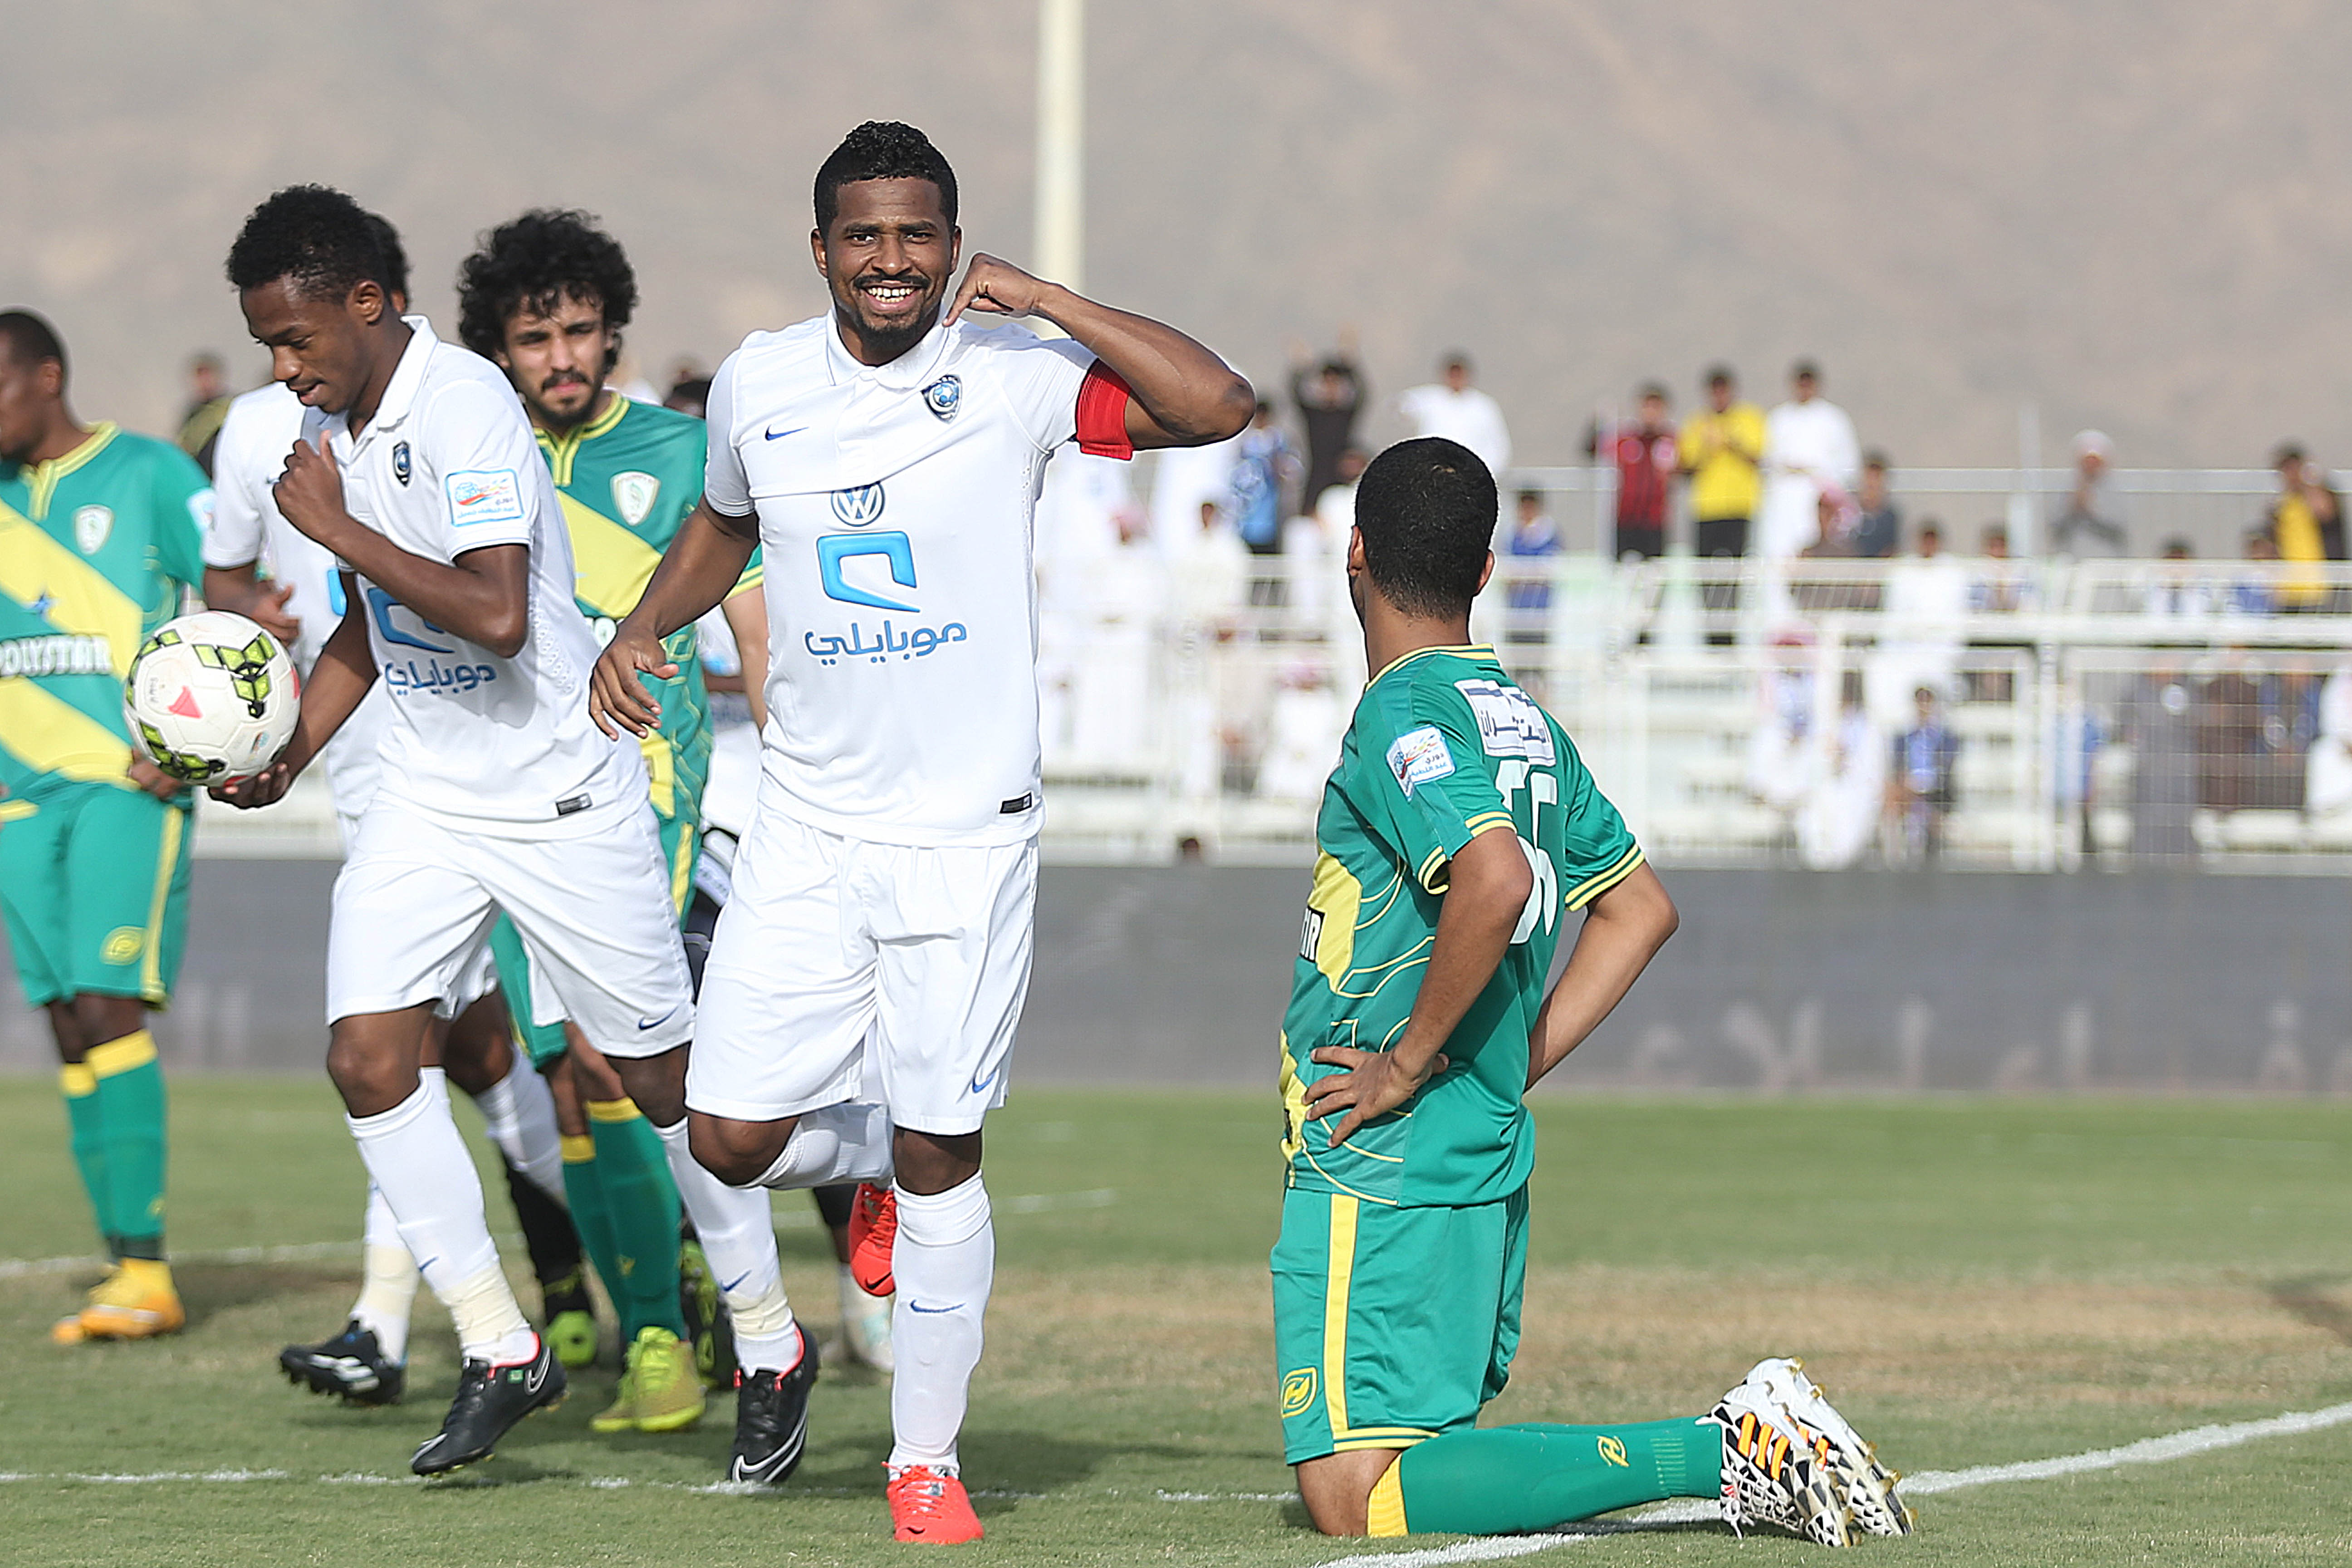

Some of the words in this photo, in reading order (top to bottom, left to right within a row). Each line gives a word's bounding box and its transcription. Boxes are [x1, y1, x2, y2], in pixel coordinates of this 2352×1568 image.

[0, 635, 112, 676] OLYSTAR
[805, 620, 967, 665] موبايلي
[385, 658, 496, 695] موبايلي
